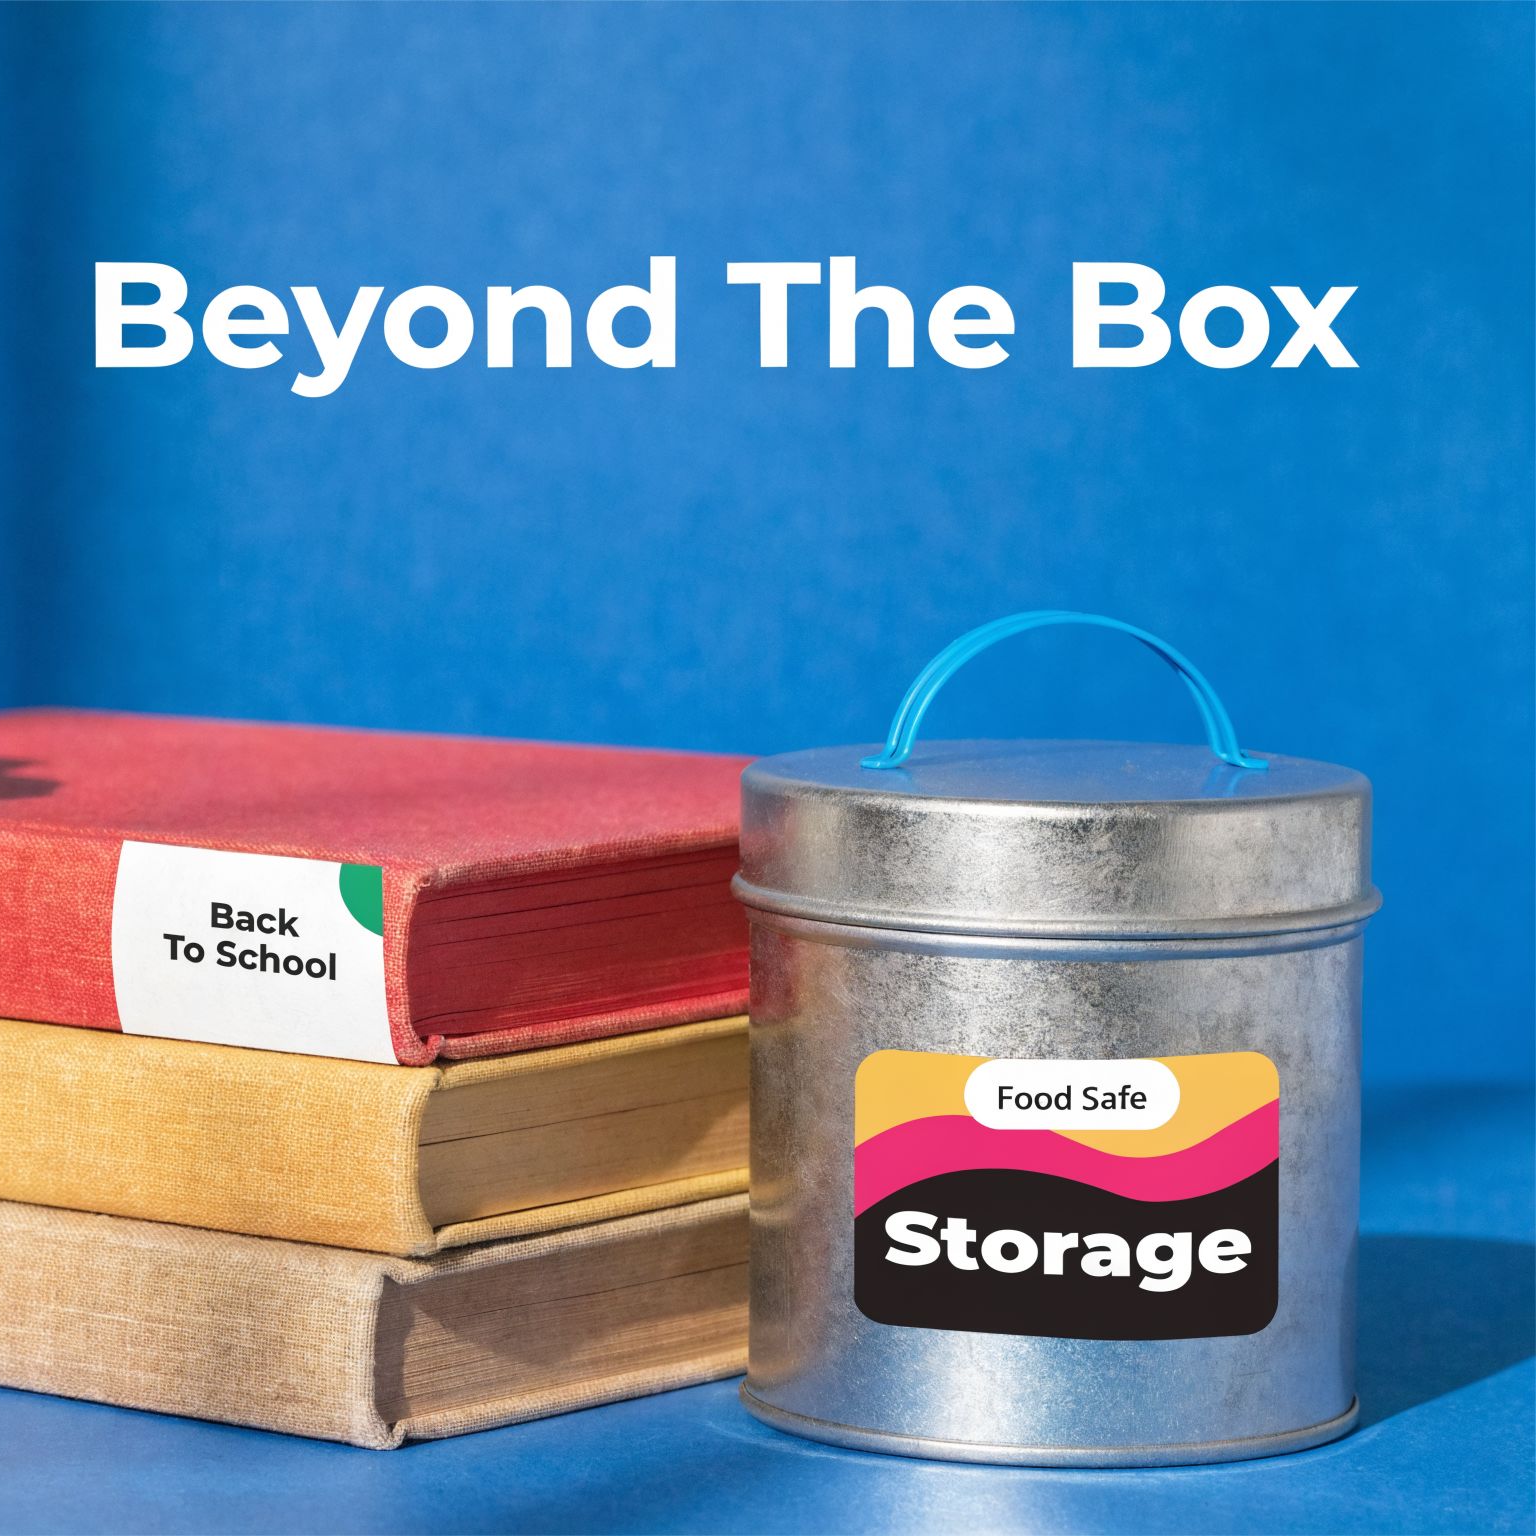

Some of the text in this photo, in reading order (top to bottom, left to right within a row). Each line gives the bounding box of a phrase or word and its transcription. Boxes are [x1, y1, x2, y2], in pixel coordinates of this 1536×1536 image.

[211, 901, 299, 937] Back
[163, 933, 336, 981] To School
[998, 1084, 1147, 1110] Food Safe
[884, 1210, 1252, 1293] Storage
